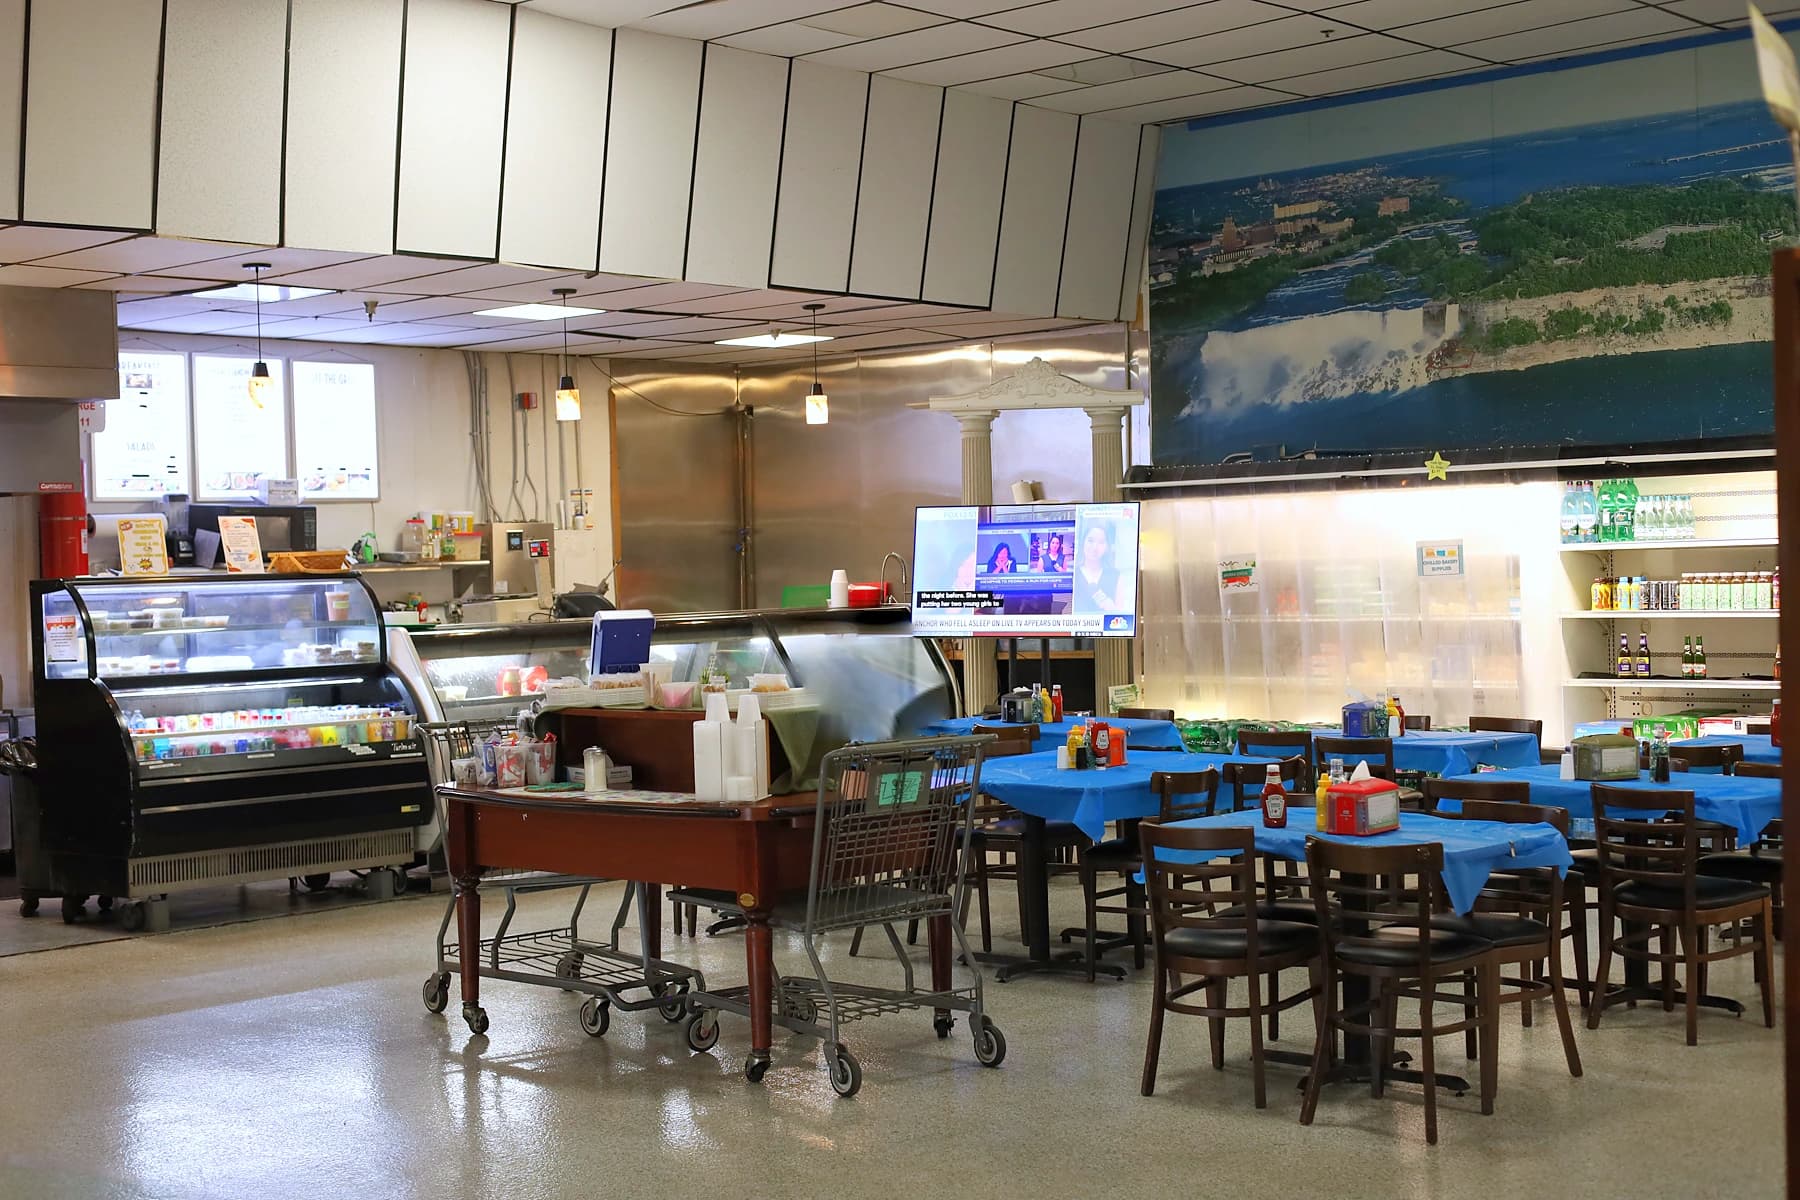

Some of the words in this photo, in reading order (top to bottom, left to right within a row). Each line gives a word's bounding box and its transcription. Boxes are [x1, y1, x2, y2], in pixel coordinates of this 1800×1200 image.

[931, 592, 945, 600] night
[1024, 619, 1051, 627] APPEARS
[1052, 619, 1061, 627] ON
[1062, 619, 1081, 627] TODAY
[1082, 619, 1100, 627] SHOW
